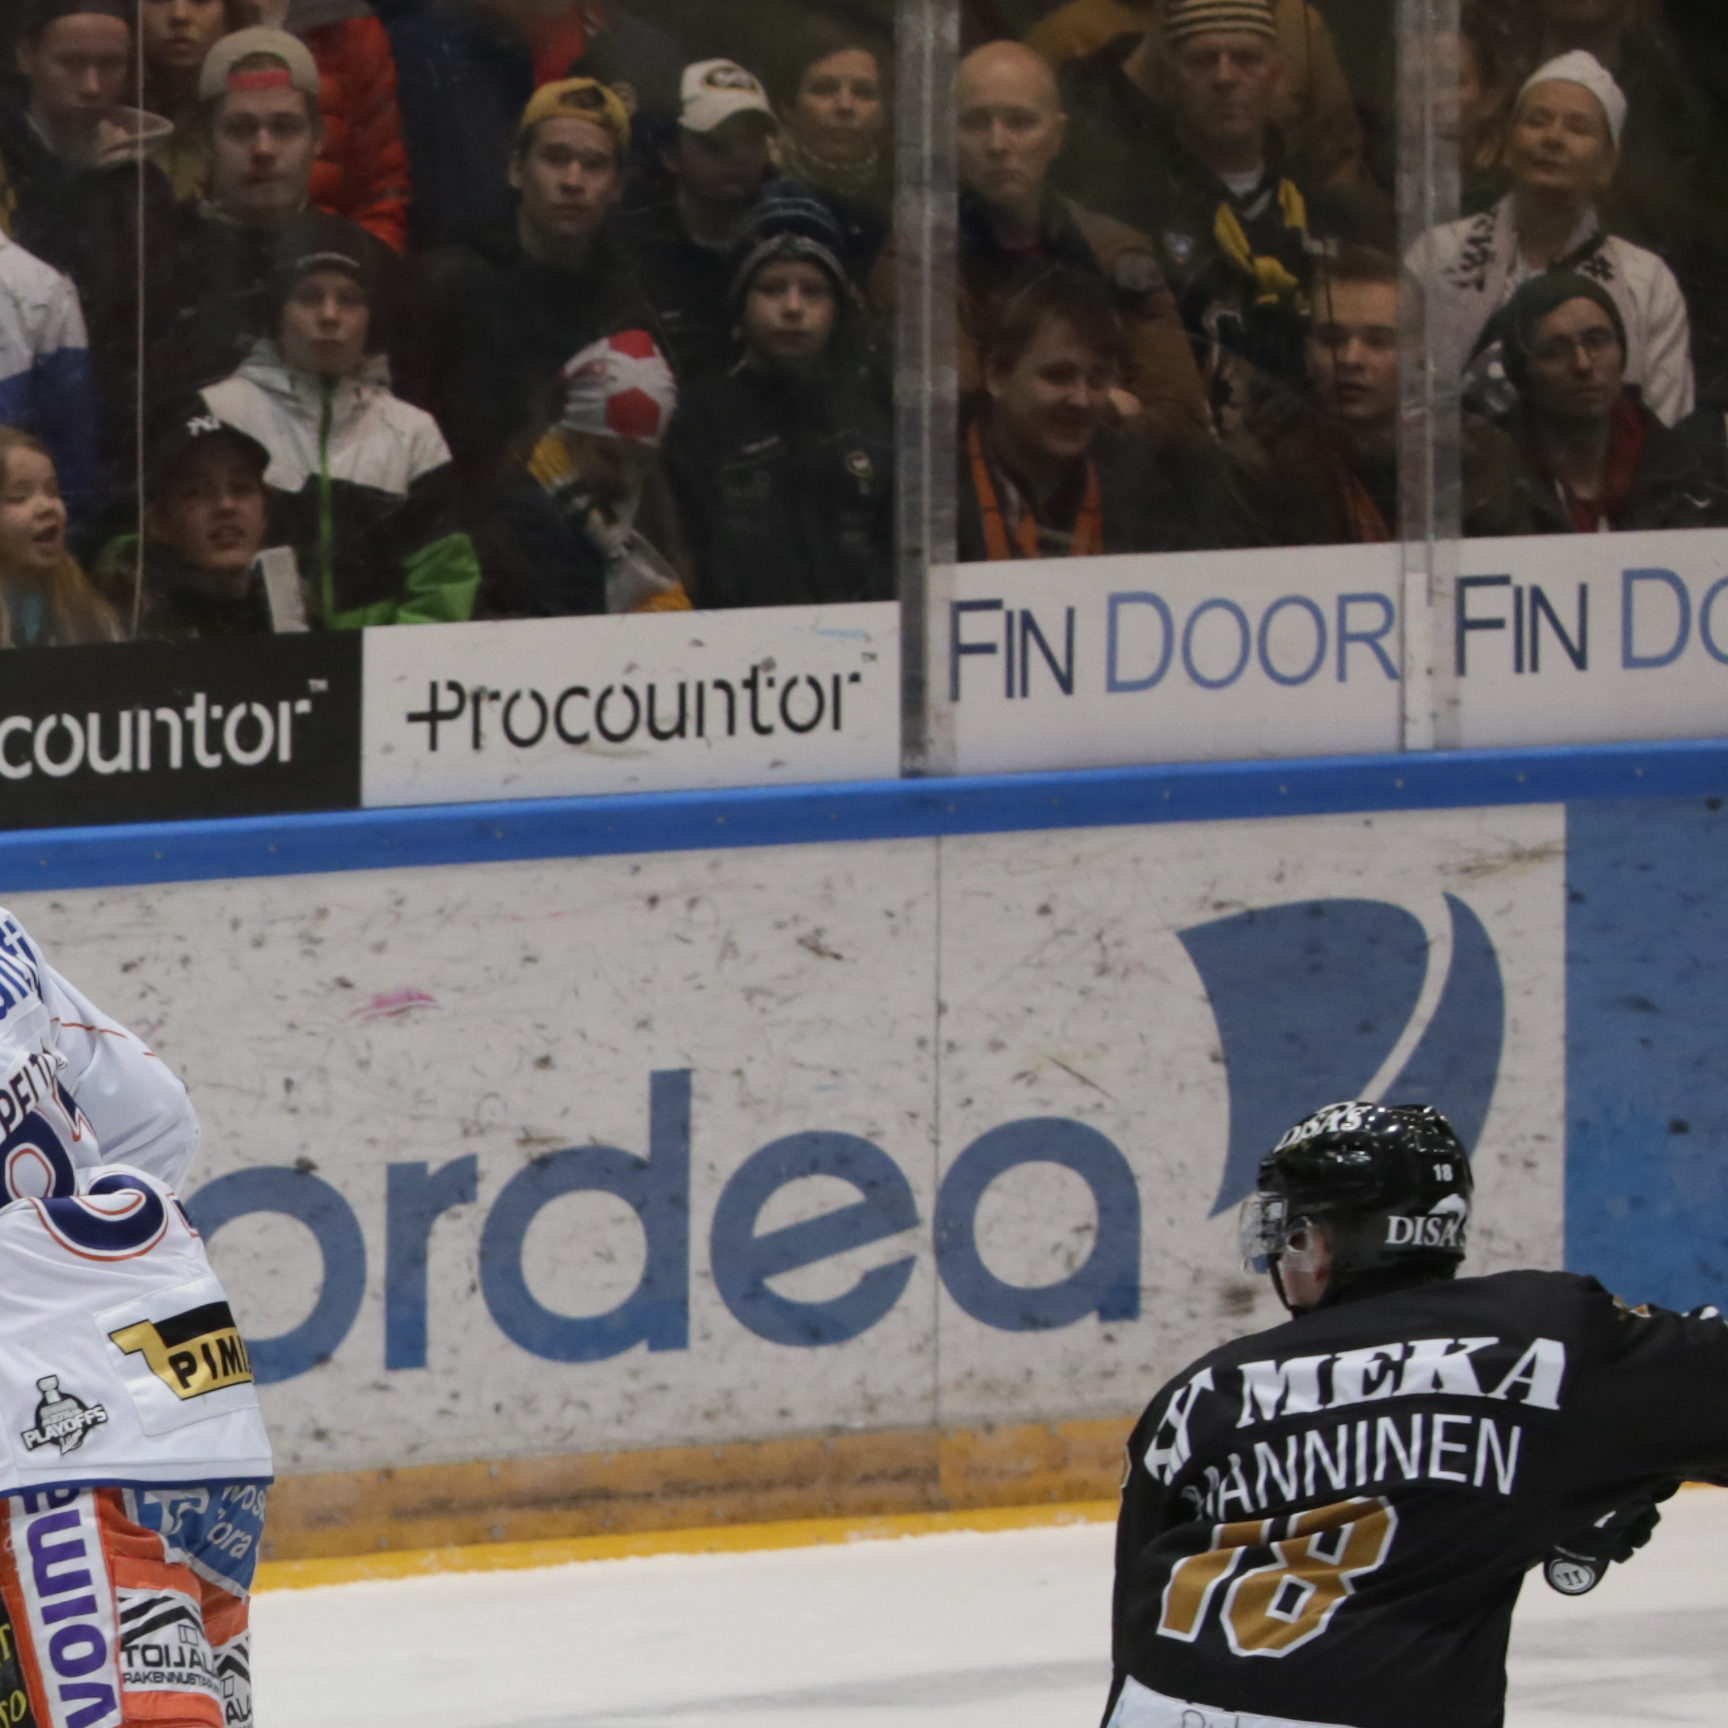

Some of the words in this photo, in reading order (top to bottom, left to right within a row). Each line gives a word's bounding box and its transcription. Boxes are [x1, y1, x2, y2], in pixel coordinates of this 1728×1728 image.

[950, 599, 1074, 701] FIN
[1106, 590, 1400, 693] DOOR
[1455, 573, 1588, 676] FIN
[406, 664, 862, 752] Procountor
[1432, 1163, 1454, 1183] 18
[21, 1404, 108, 1452] PLAYOFFS
[1237, 1336, 1566, 1430] MEKA
[1156, 1495, 1399, 1658] 18
